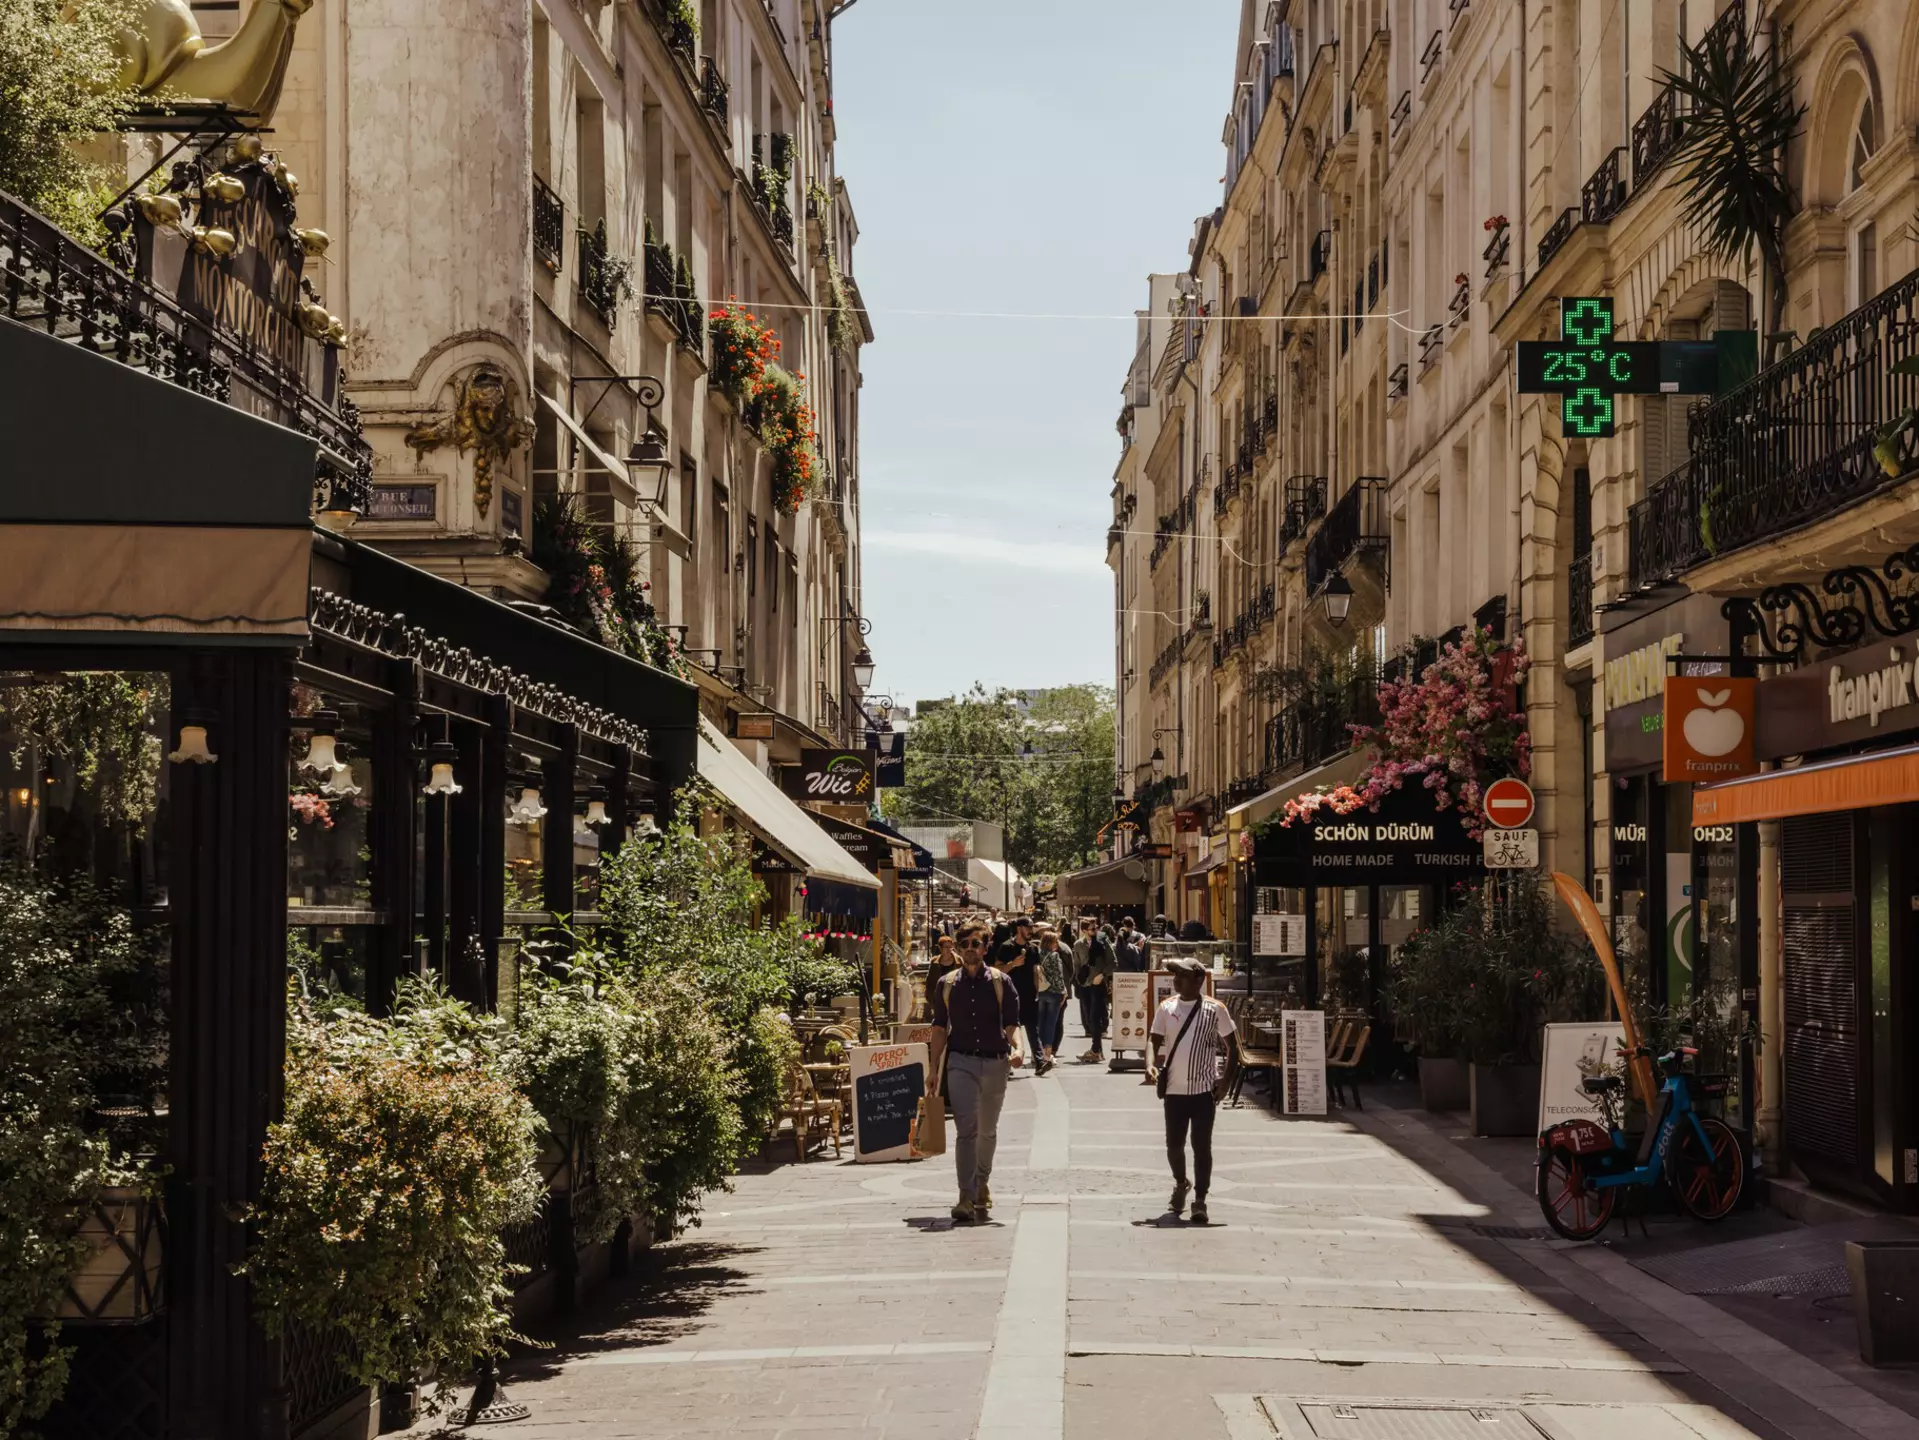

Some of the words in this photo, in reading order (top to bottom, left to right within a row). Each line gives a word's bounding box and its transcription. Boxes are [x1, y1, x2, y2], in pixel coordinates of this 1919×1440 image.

[1543, 350, 1631, 381] 25°C
[381, 492, 408, 501] RUE
[1828, 646, 1914, 728] franprix
[832, 762, 862, 776] Belgian
[1684, 758, 1741, 773] franprix
[805, 772, 852, 794] Wic
[831, 831, 863, 841] Waffles
[1314, 823, 1369, 841] SCHÖN
[1375, 823, 1434, 841] DÜRÜM
[1494, 831, 1529, 842] SAUF
[1312, 855, 1354, 867] HOME
[1355, 854, 1394, 866] MADE
[1414, 853, 1470, 866] TURKISH
[870, 1047, 909, 1067] APEROL
[876, 1057, 903, 1071] SPRITZ
[1658, 1121, 1675, 1157] dott
